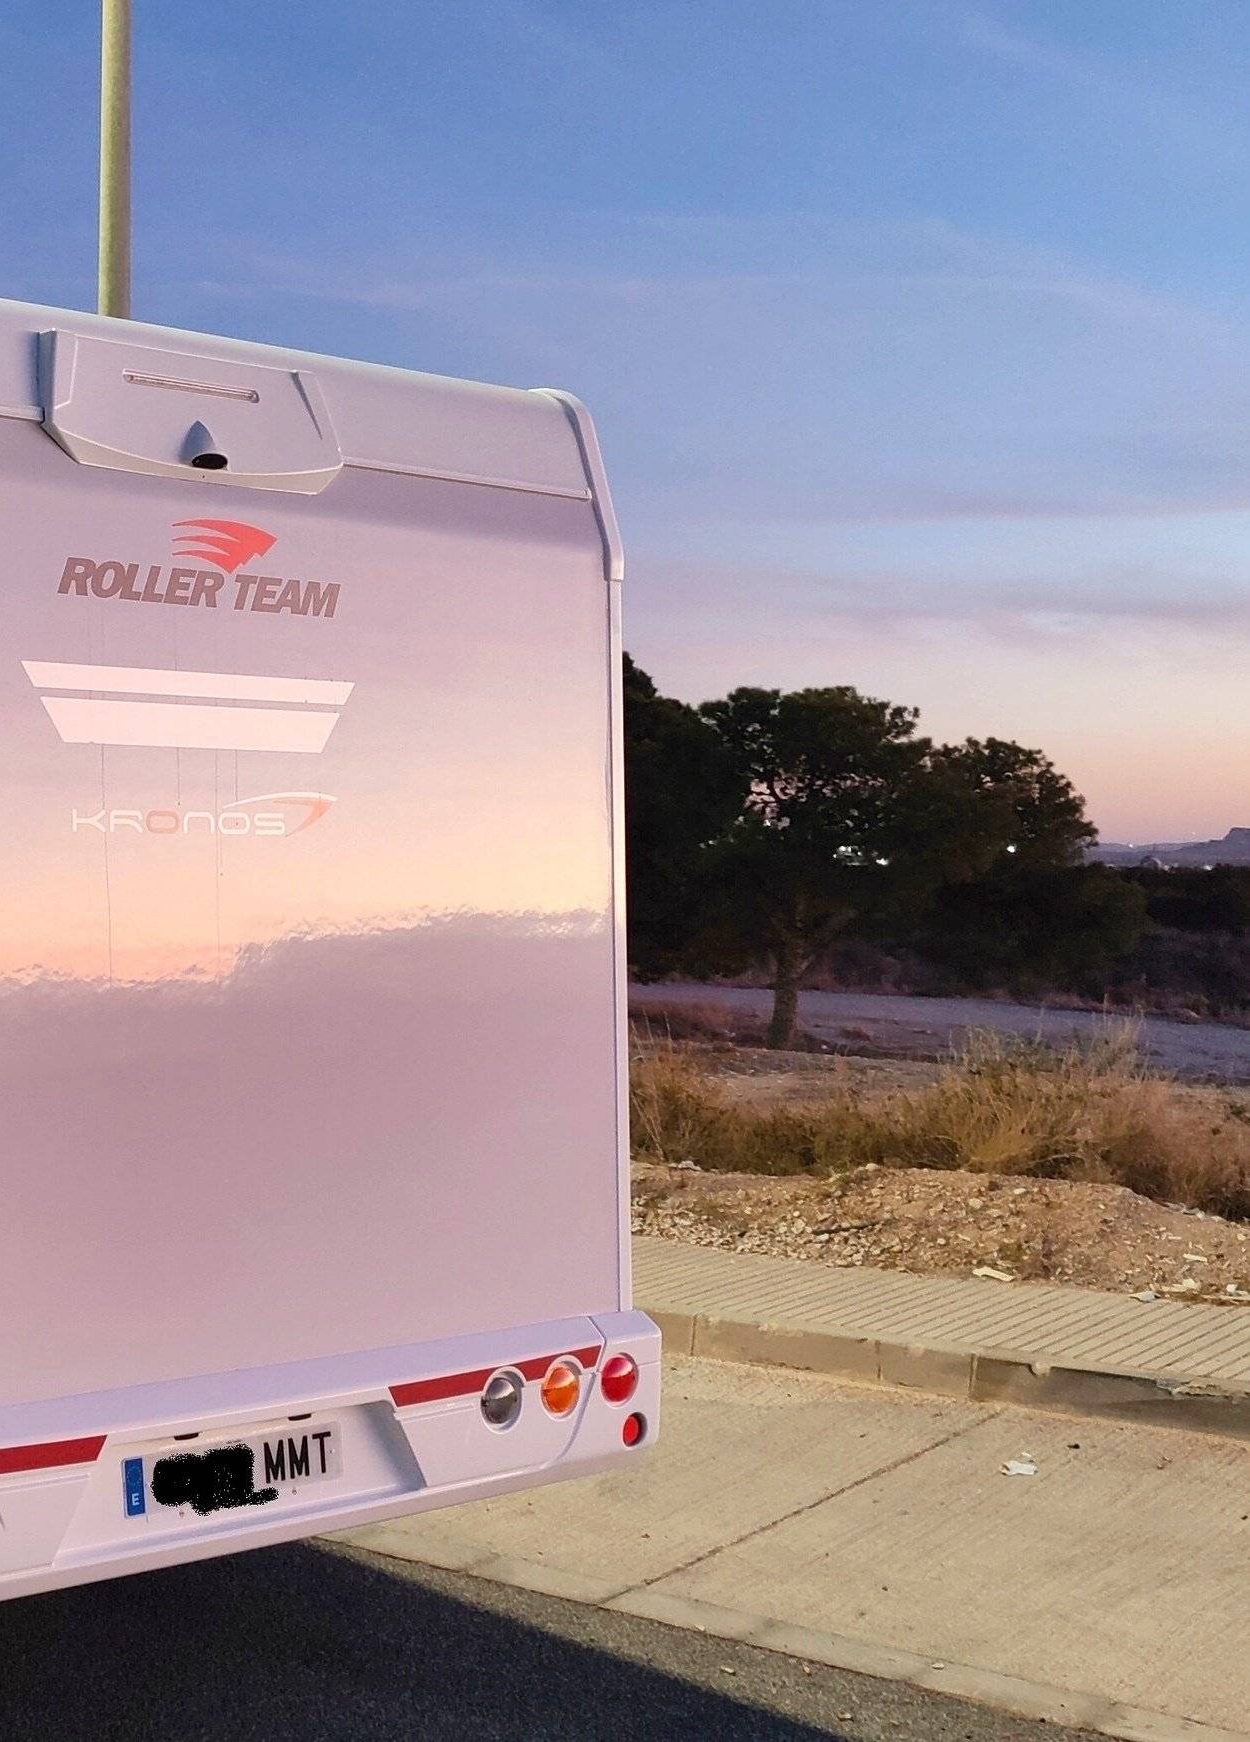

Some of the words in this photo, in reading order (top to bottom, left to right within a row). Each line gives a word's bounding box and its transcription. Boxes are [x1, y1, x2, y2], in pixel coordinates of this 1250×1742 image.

[56, 556, 225, 609] ROLLER
[234, 573, 342, 619] TEAM
[71, 807, 286, 837] KRONOS
[262, 1430, 332, 1485] MMT
[131, 1492, 140, 1507] E
